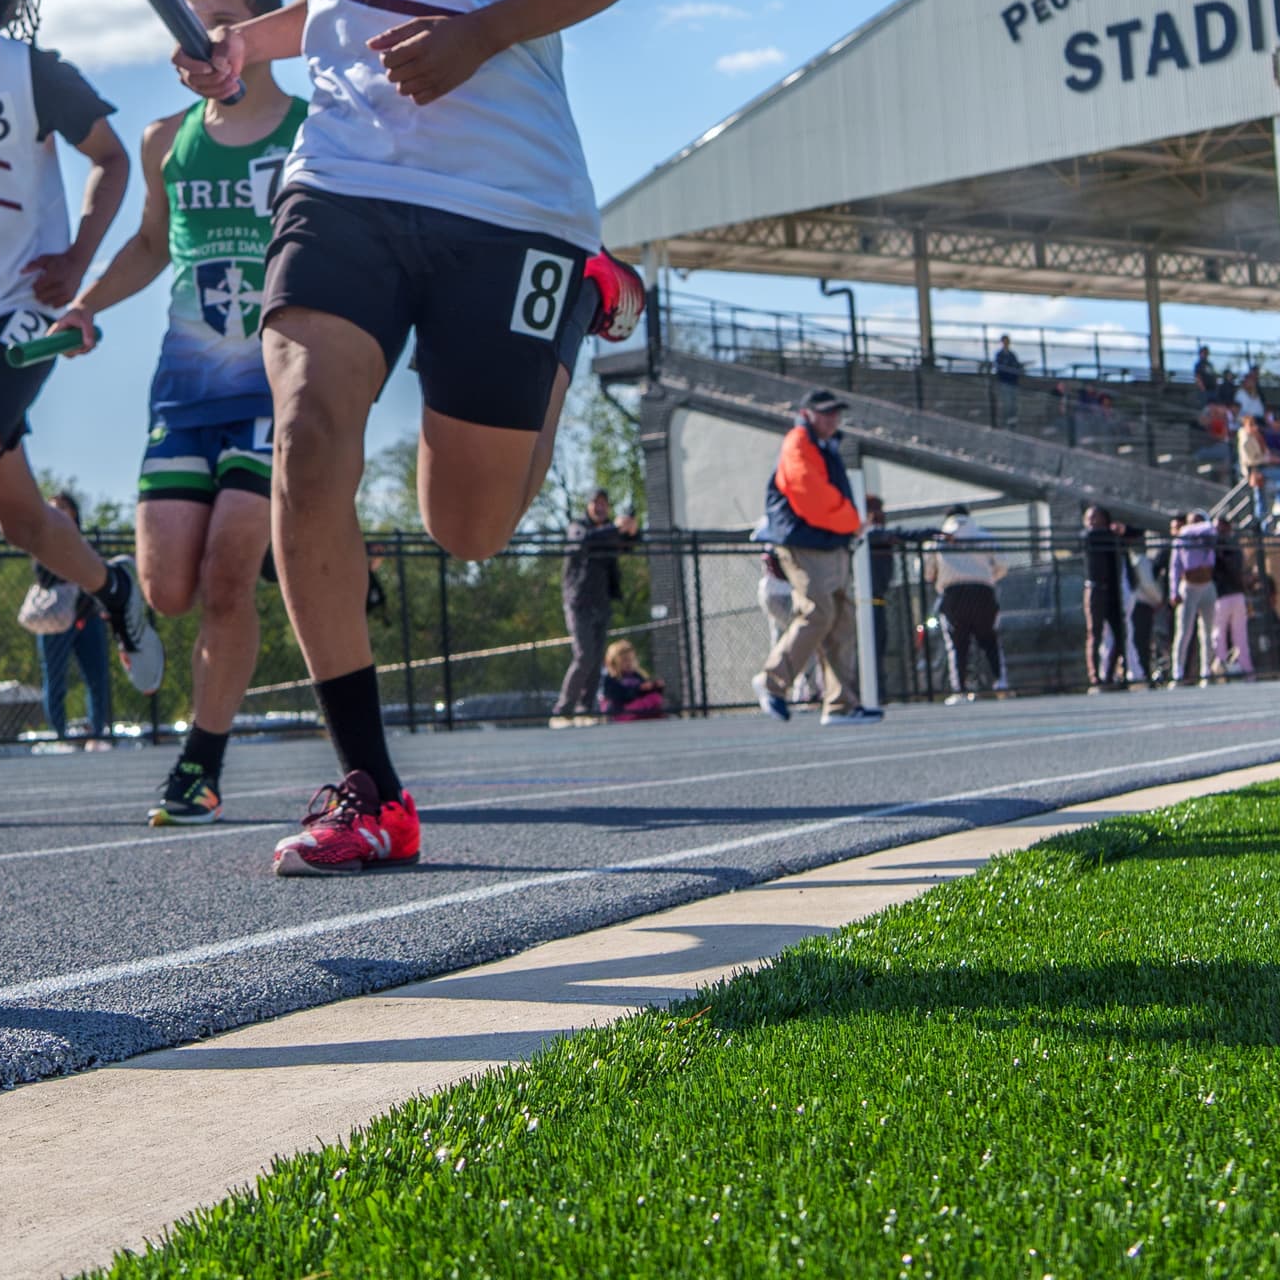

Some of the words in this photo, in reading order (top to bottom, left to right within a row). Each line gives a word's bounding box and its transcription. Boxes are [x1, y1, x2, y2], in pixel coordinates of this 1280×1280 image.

[176, 179, 254, 210] IRIS
[255, 159, 284, 211] 7
[207, 226, 260, 240] PEORIA
[522, 260, 563, 330] 8
